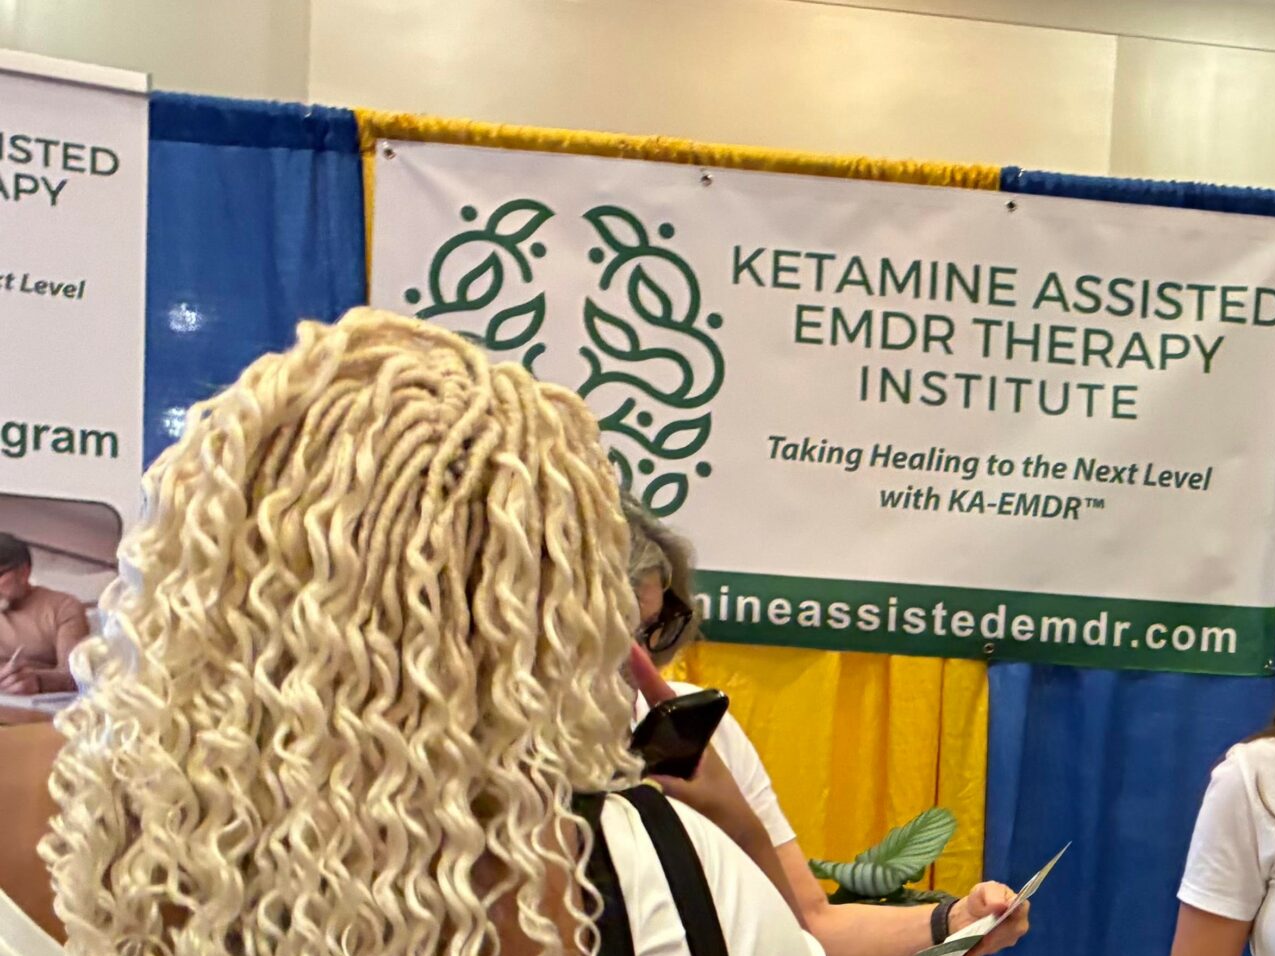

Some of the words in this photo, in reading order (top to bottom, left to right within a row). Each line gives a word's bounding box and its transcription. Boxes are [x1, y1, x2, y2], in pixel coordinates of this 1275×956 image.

[20, 273, 86, 299] Level
[732, 245, 1017, 306] KETAMINE
[794, 304, 955, 354] EMDR
[972, 318, 1224, 373] THERAPY
[859, 365, 1138, 419] INSTITUTE
[1, 420, 119, 458] gram
[767, 435, 863, 470] Taking
[870, 444, 979, 480] Healing
[986, 454, 1014, 477] to
[1021, 455, 1067, 479] the
[1073, 457, 1137, 485] Next
[1144, 462, 1212, 491] Level
[880, 486, 940, 511] with
